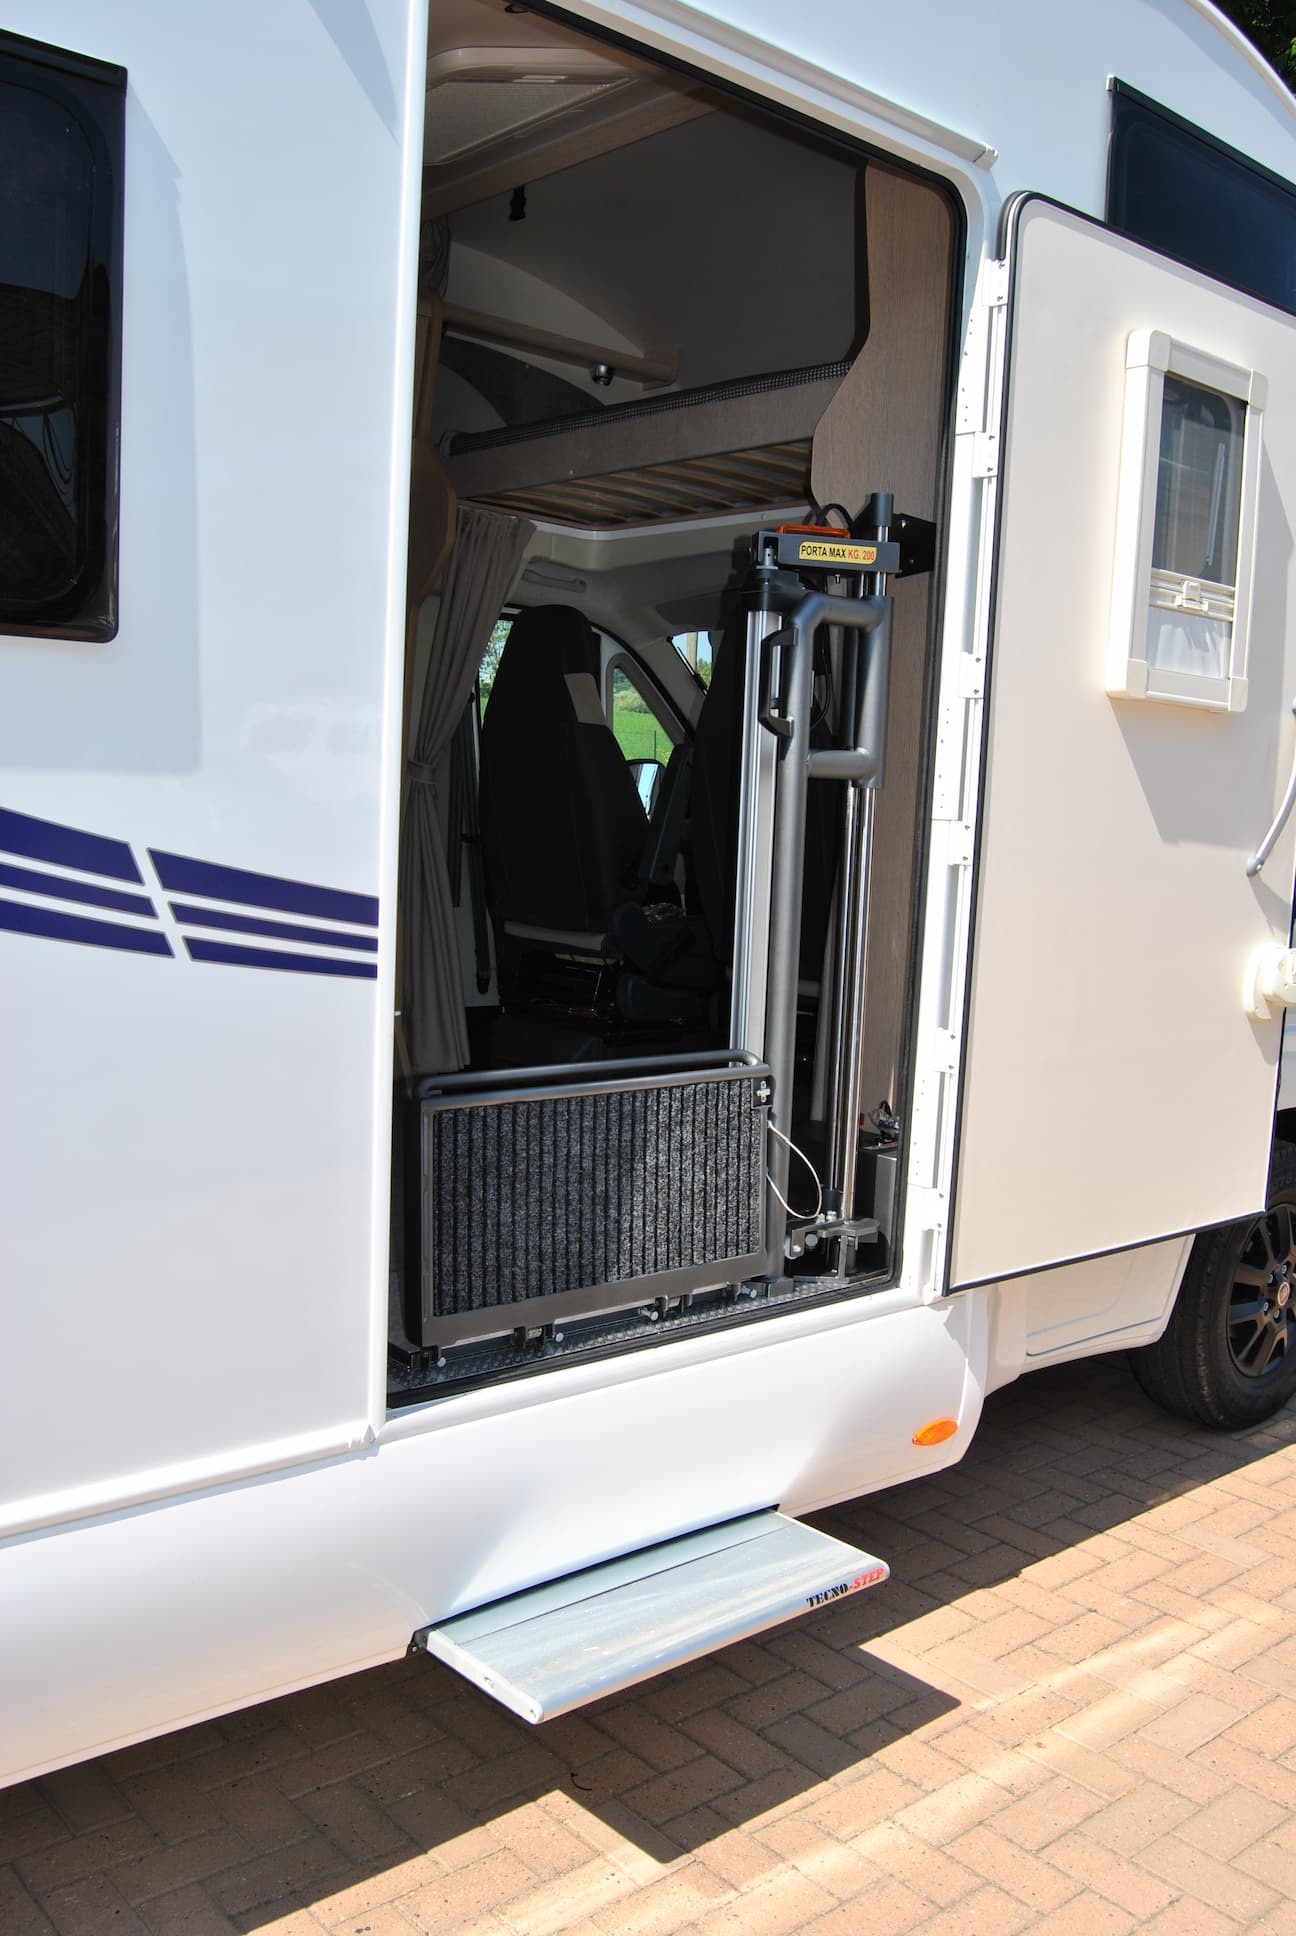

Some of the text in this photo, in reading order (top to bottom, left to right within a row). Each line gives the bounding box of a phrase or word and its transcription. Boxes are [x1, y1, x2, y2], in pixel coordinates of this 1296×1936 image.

[801, 545, 875, 561] PORTA MAX KG. 200
[806, 1567, 885, 1607] TECNO-STEP
